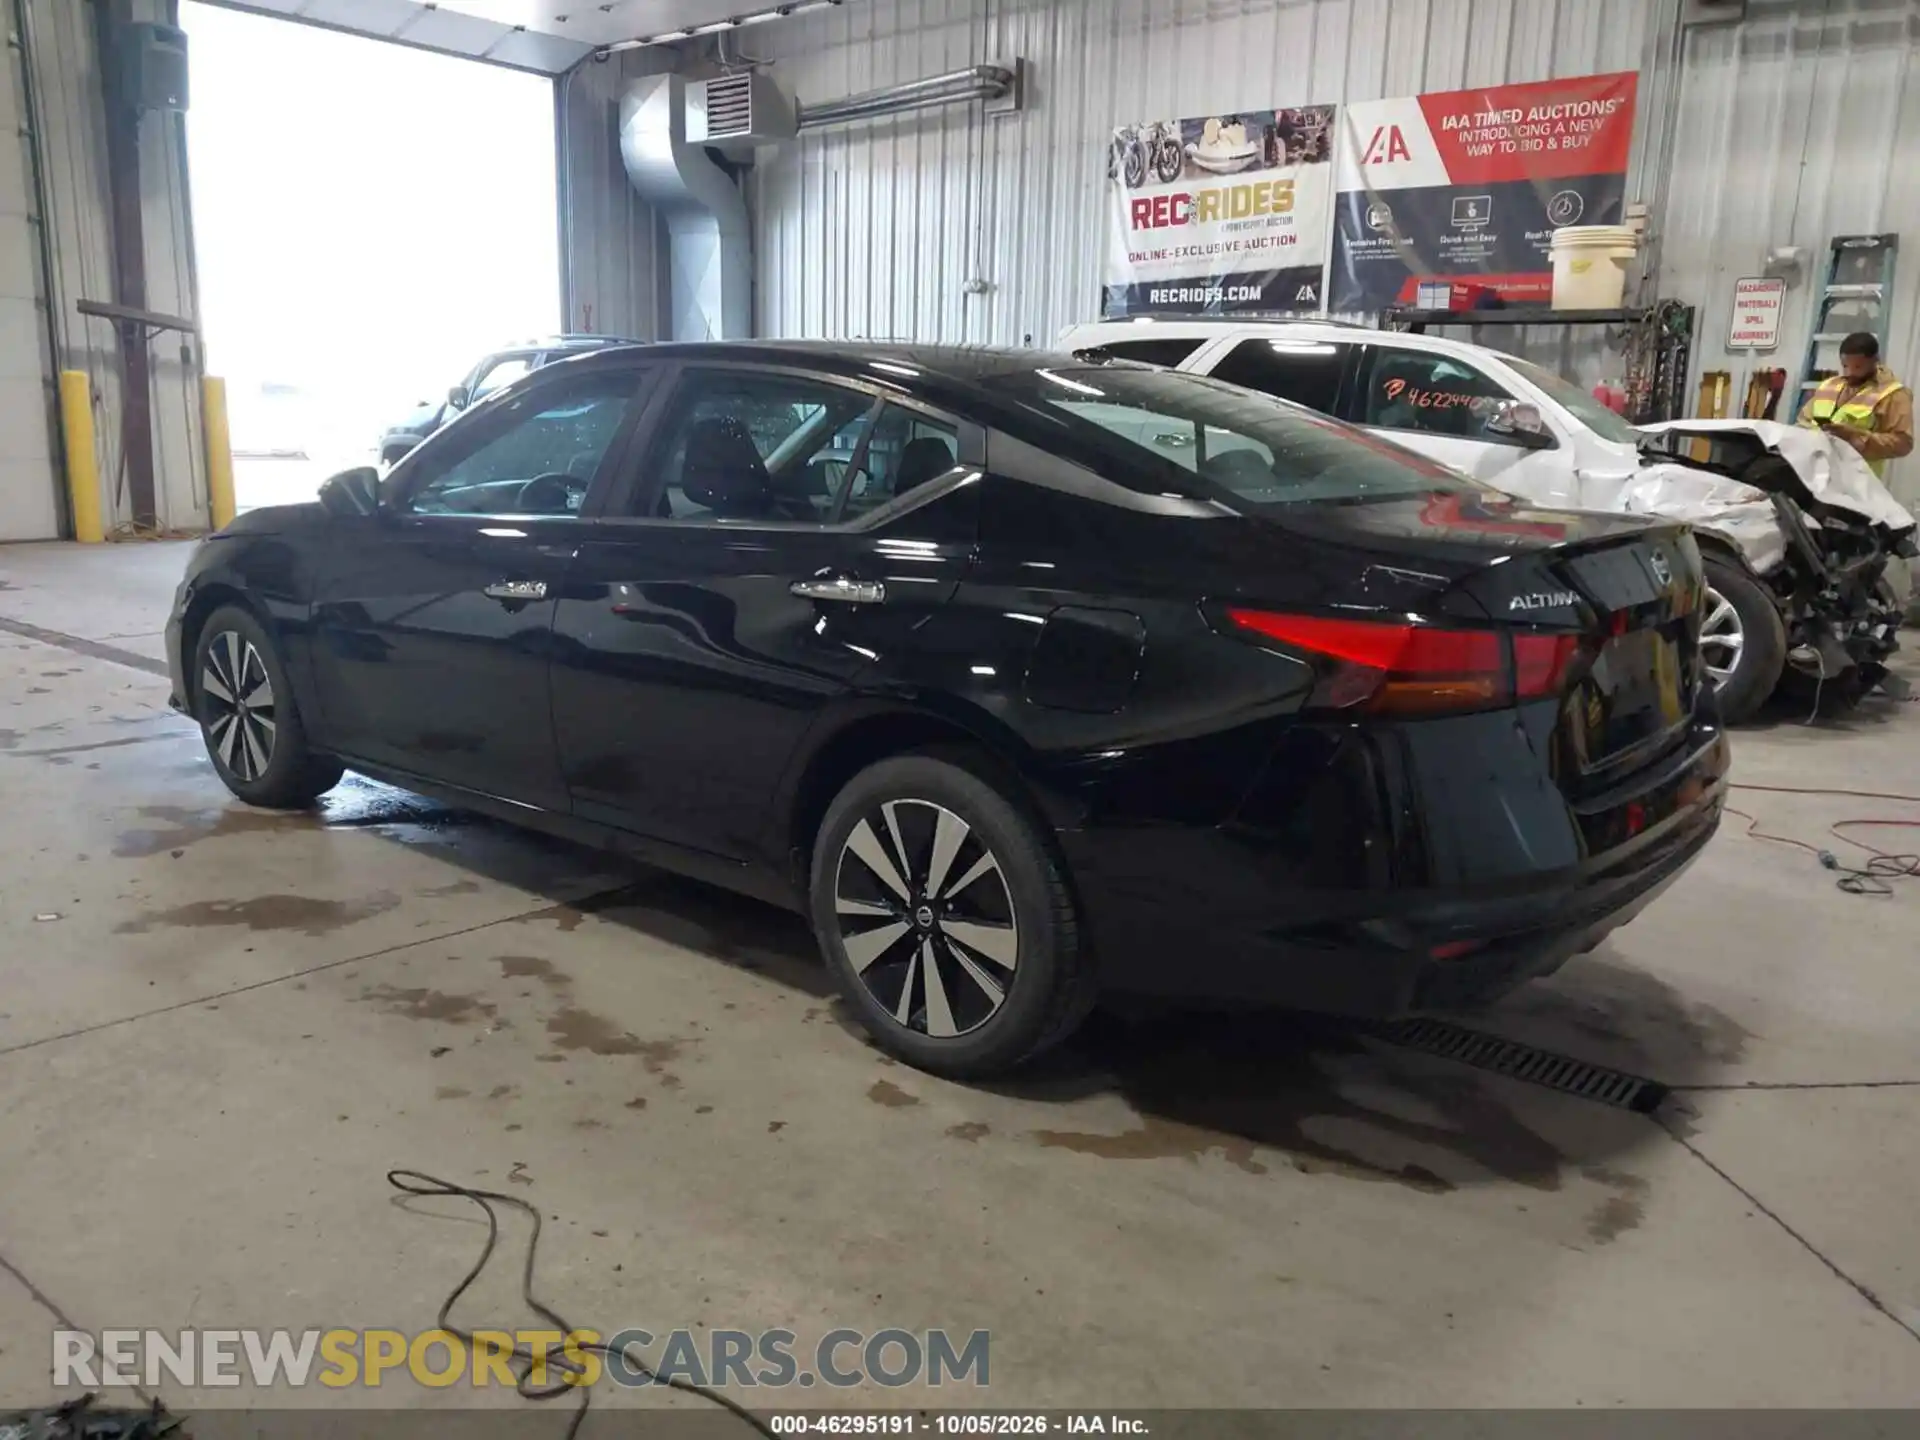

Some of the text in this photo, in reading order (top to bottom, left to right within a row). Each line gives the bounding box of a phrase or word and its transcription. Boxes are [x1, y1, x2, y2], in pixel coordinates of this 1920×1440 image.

[1442, 115, 1470, 130] IAA
[1475, 108, 1523, 126] TIMED
[1554, 121, 1566, 134] A
[1569, 118, 1605, 133] NEW
[1467, 134, 1592, 157] WAY TO BID & BUY
[1131, 192, 1191, 231] REC
[1199, 178, 1295, 223] RIDES
[1129, 240, 1241, 263] ONLINE-EXCLUSIVE
[1244, 234, 1297, 250] AUCTION
